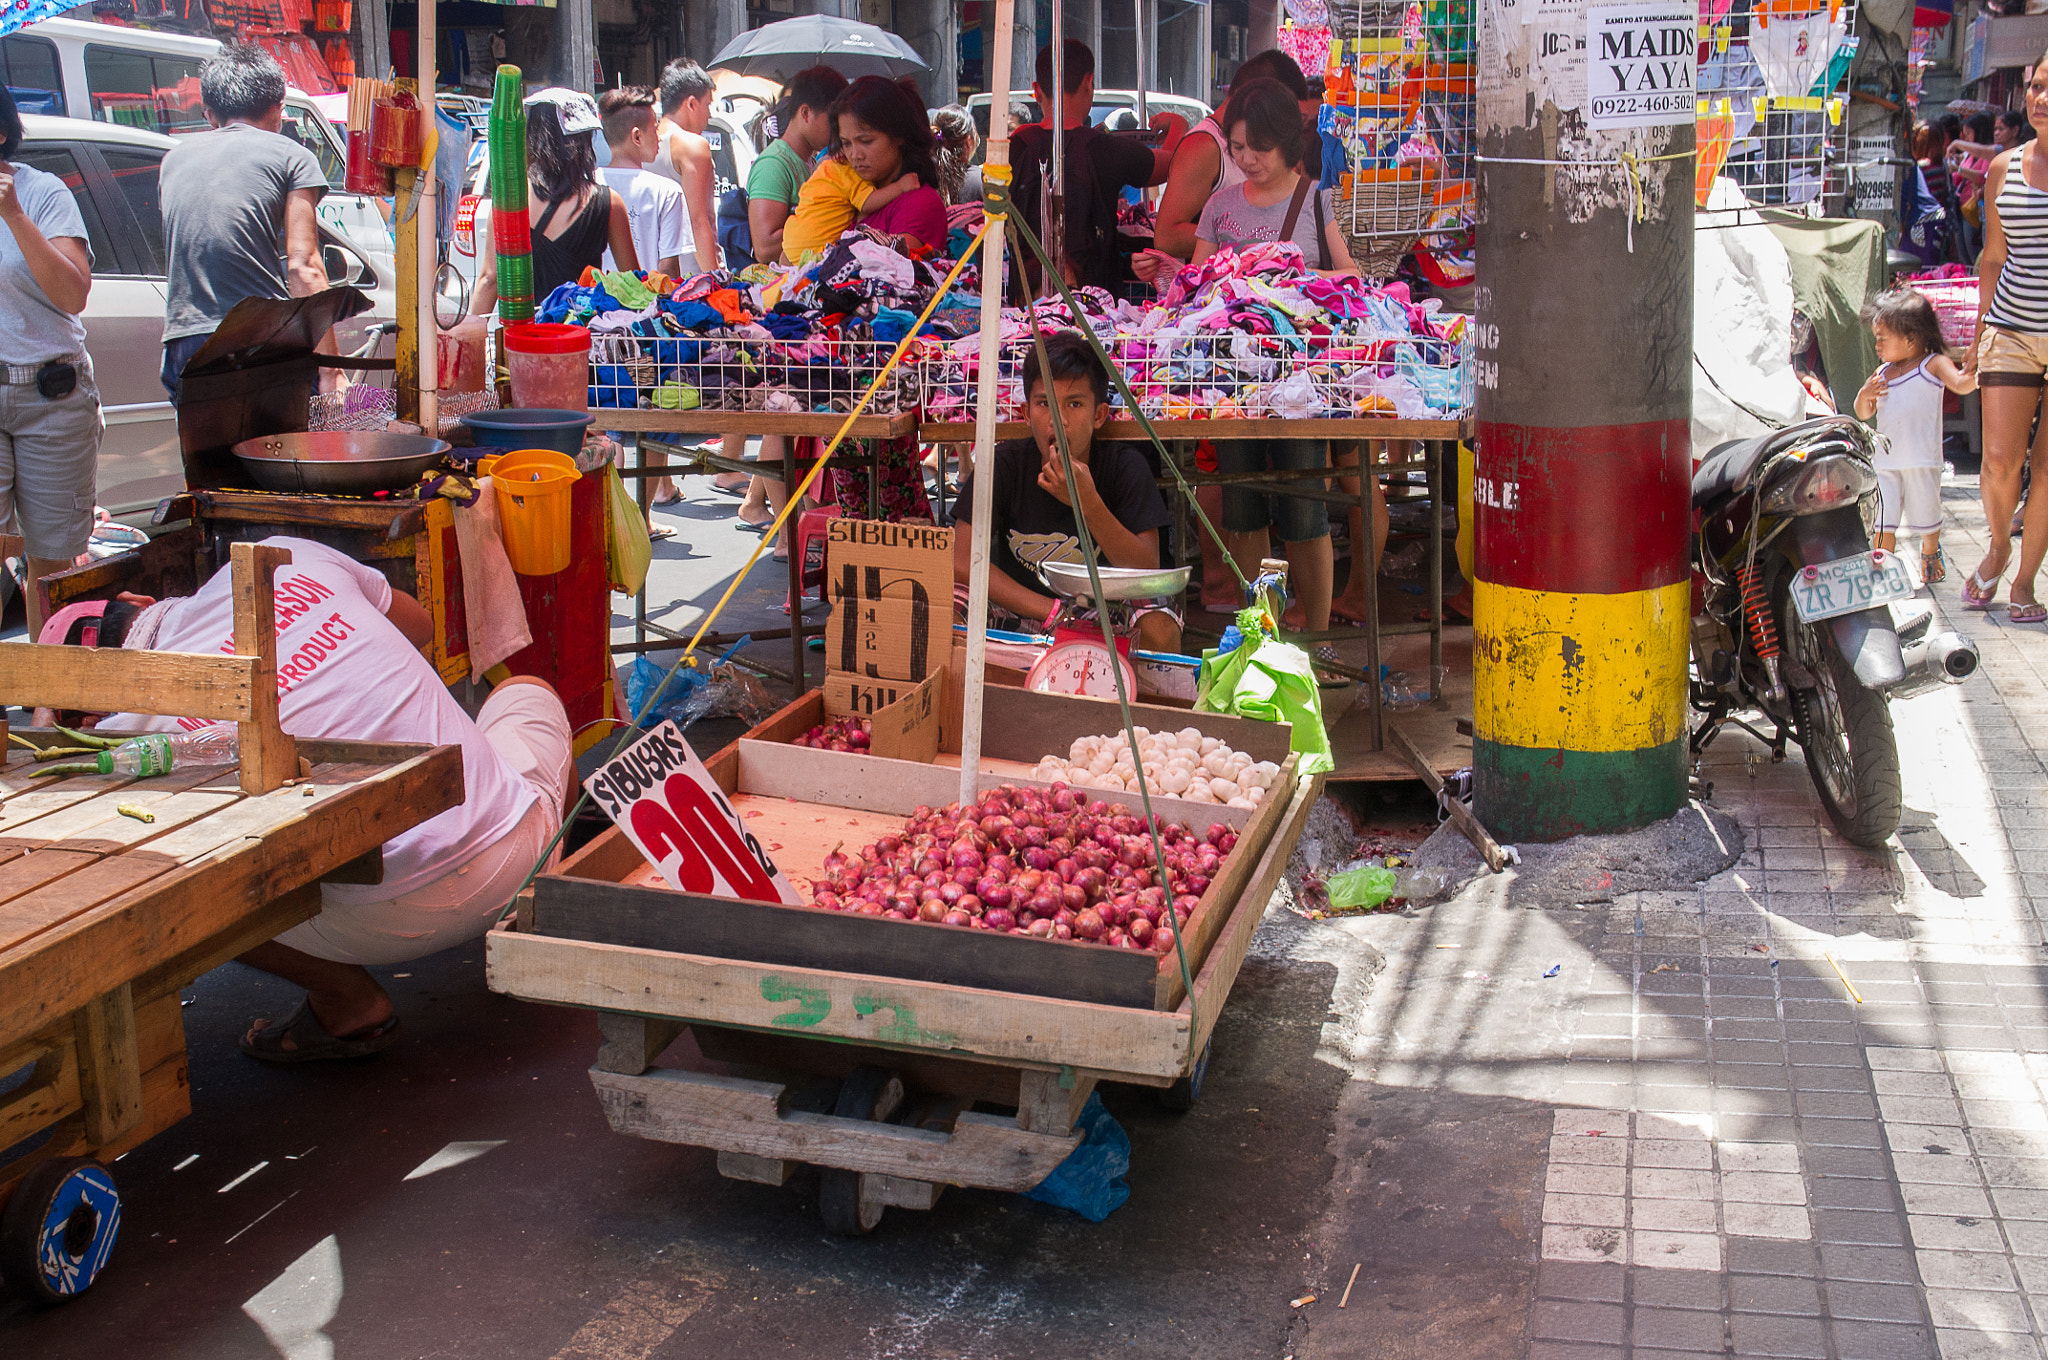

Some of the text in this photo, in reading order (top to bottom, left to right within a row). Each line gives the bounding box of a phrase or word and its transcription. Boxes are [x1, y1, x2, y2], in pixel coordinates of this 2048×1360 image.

[1599, 27, 1694, 60] MAIDS
[1609, 61, 1691, 92] YAYA
[1593, 94, 1694, 115] 0922-460-5021
[828, 520, 949, 550] SIBUYAS
[1820, 566, 1844, 582] MC
[1800, 584, 1836, 613] ZR
[834, 563, 930, 684] 15
[277, 612, 356, 692] PRODUCT
[593, 725, 687, 820] SIBUYAS
[630, 772, 783, 905] 20
